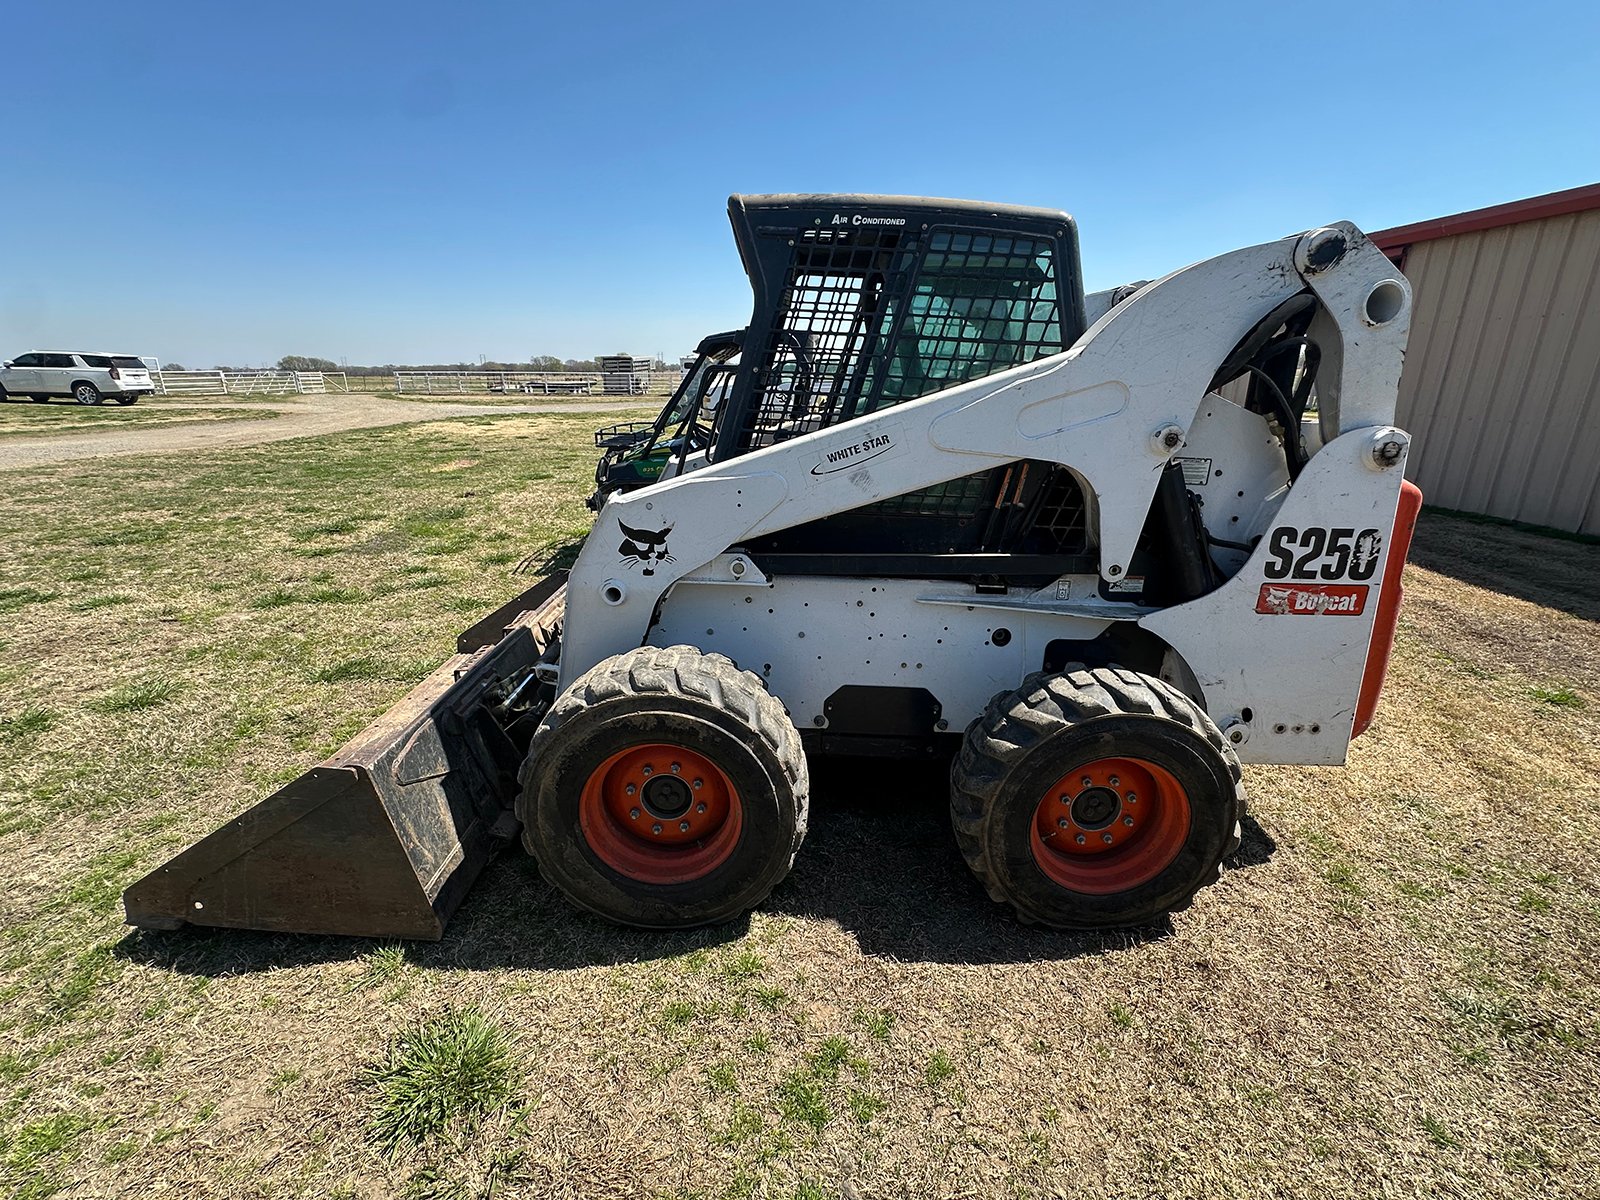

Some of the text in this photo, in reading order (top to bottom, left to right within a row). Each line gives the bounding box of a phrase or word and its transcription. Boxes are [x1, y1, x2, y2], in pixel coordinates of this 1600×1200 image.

[831, 214, 906, 225] AIR CONDITIONED
[826, 434, 890, 463] WHITE STAR
[1264, 526, 1381, 580] S250
